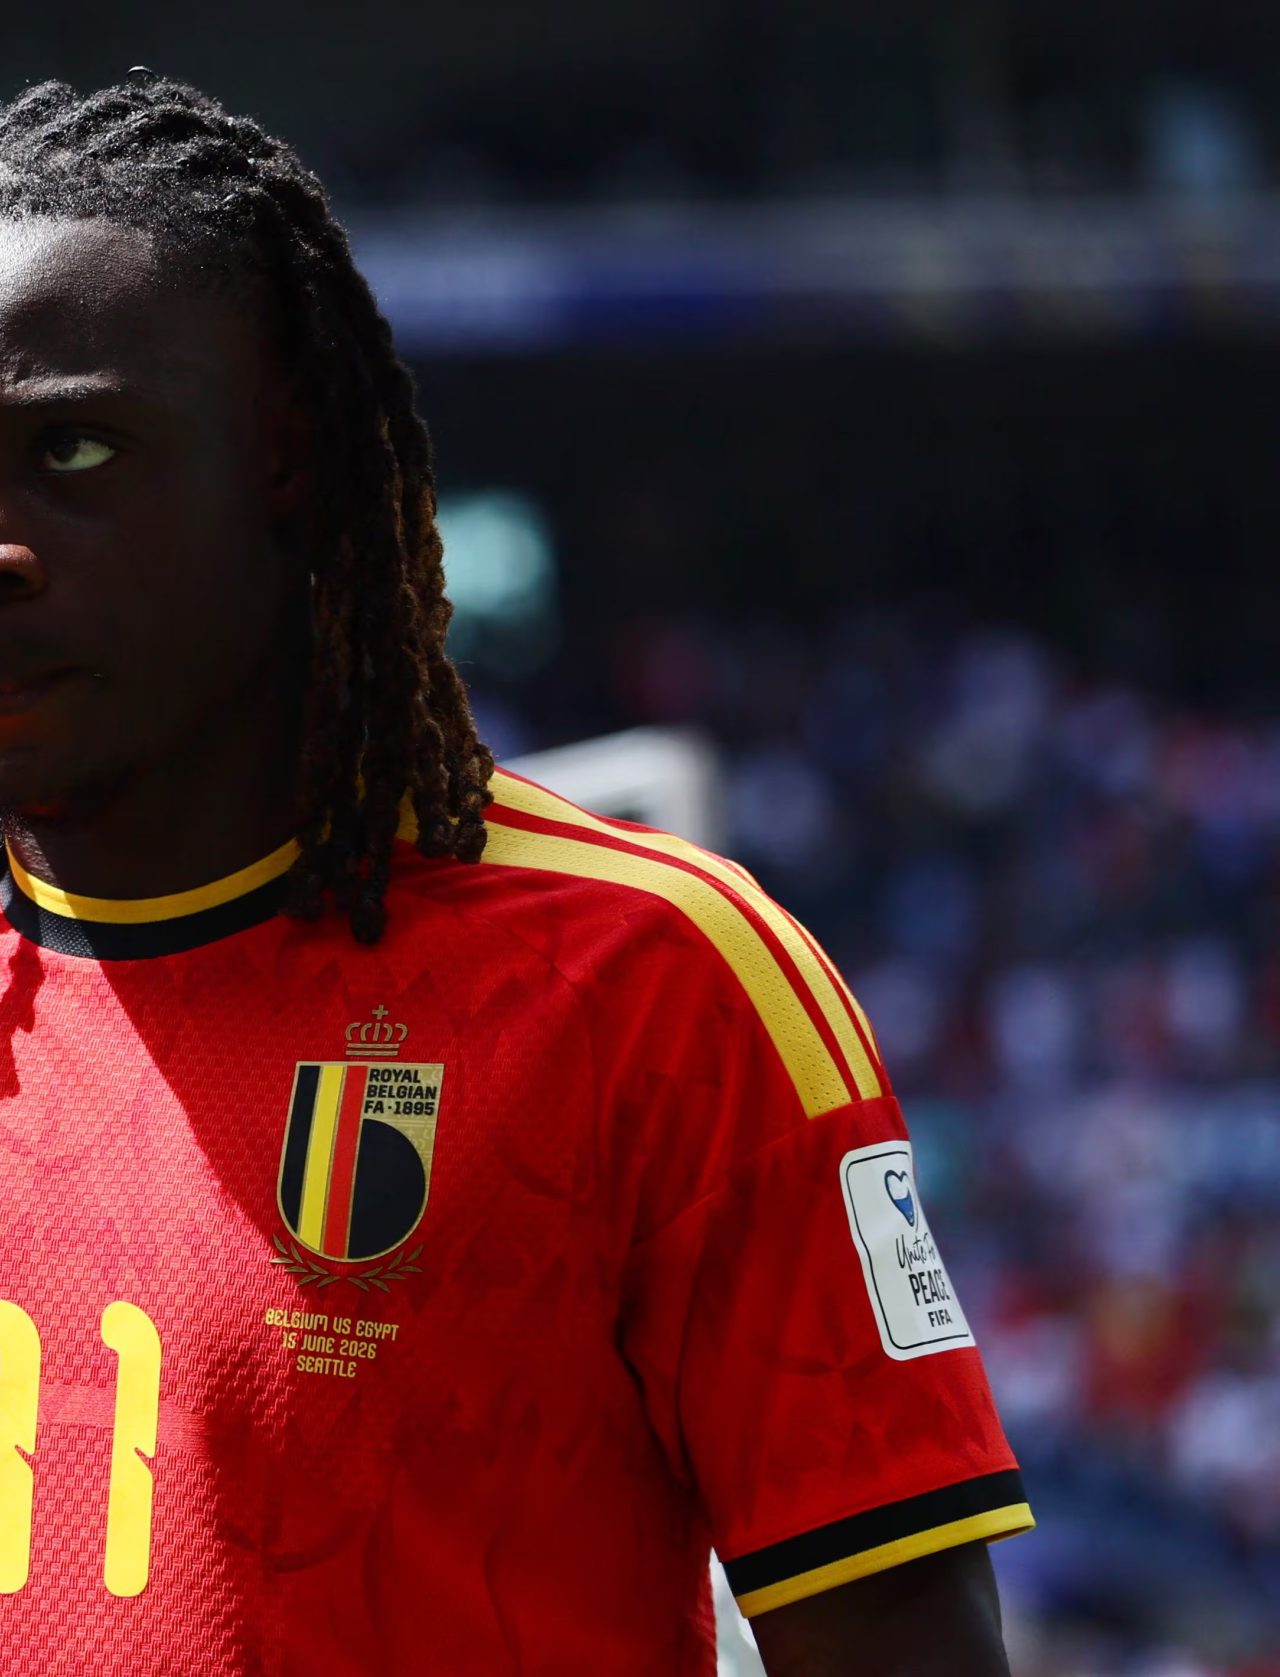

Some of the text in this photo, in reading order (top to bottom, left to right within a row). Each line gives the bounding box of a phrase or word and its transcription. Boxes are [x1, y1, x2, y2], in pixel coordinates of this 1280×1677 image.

[369, 1068, 420, 1083] ROYAL
[367, 1085, 437, 1099] BELGIAN
[364, 1101, 384, 1114] FA
[908, 1268, 950, 1306] PEACE
[265, 1308, 328, 1331] BELGIUM
[355, 1320, 400, 1341] EGYPT
[928, 1308, 953, 1327] FIFA
[282, 1331, 377, 1359] 15 JUNE 2026
[296, 1355, 357, 1378] SEATTLE
